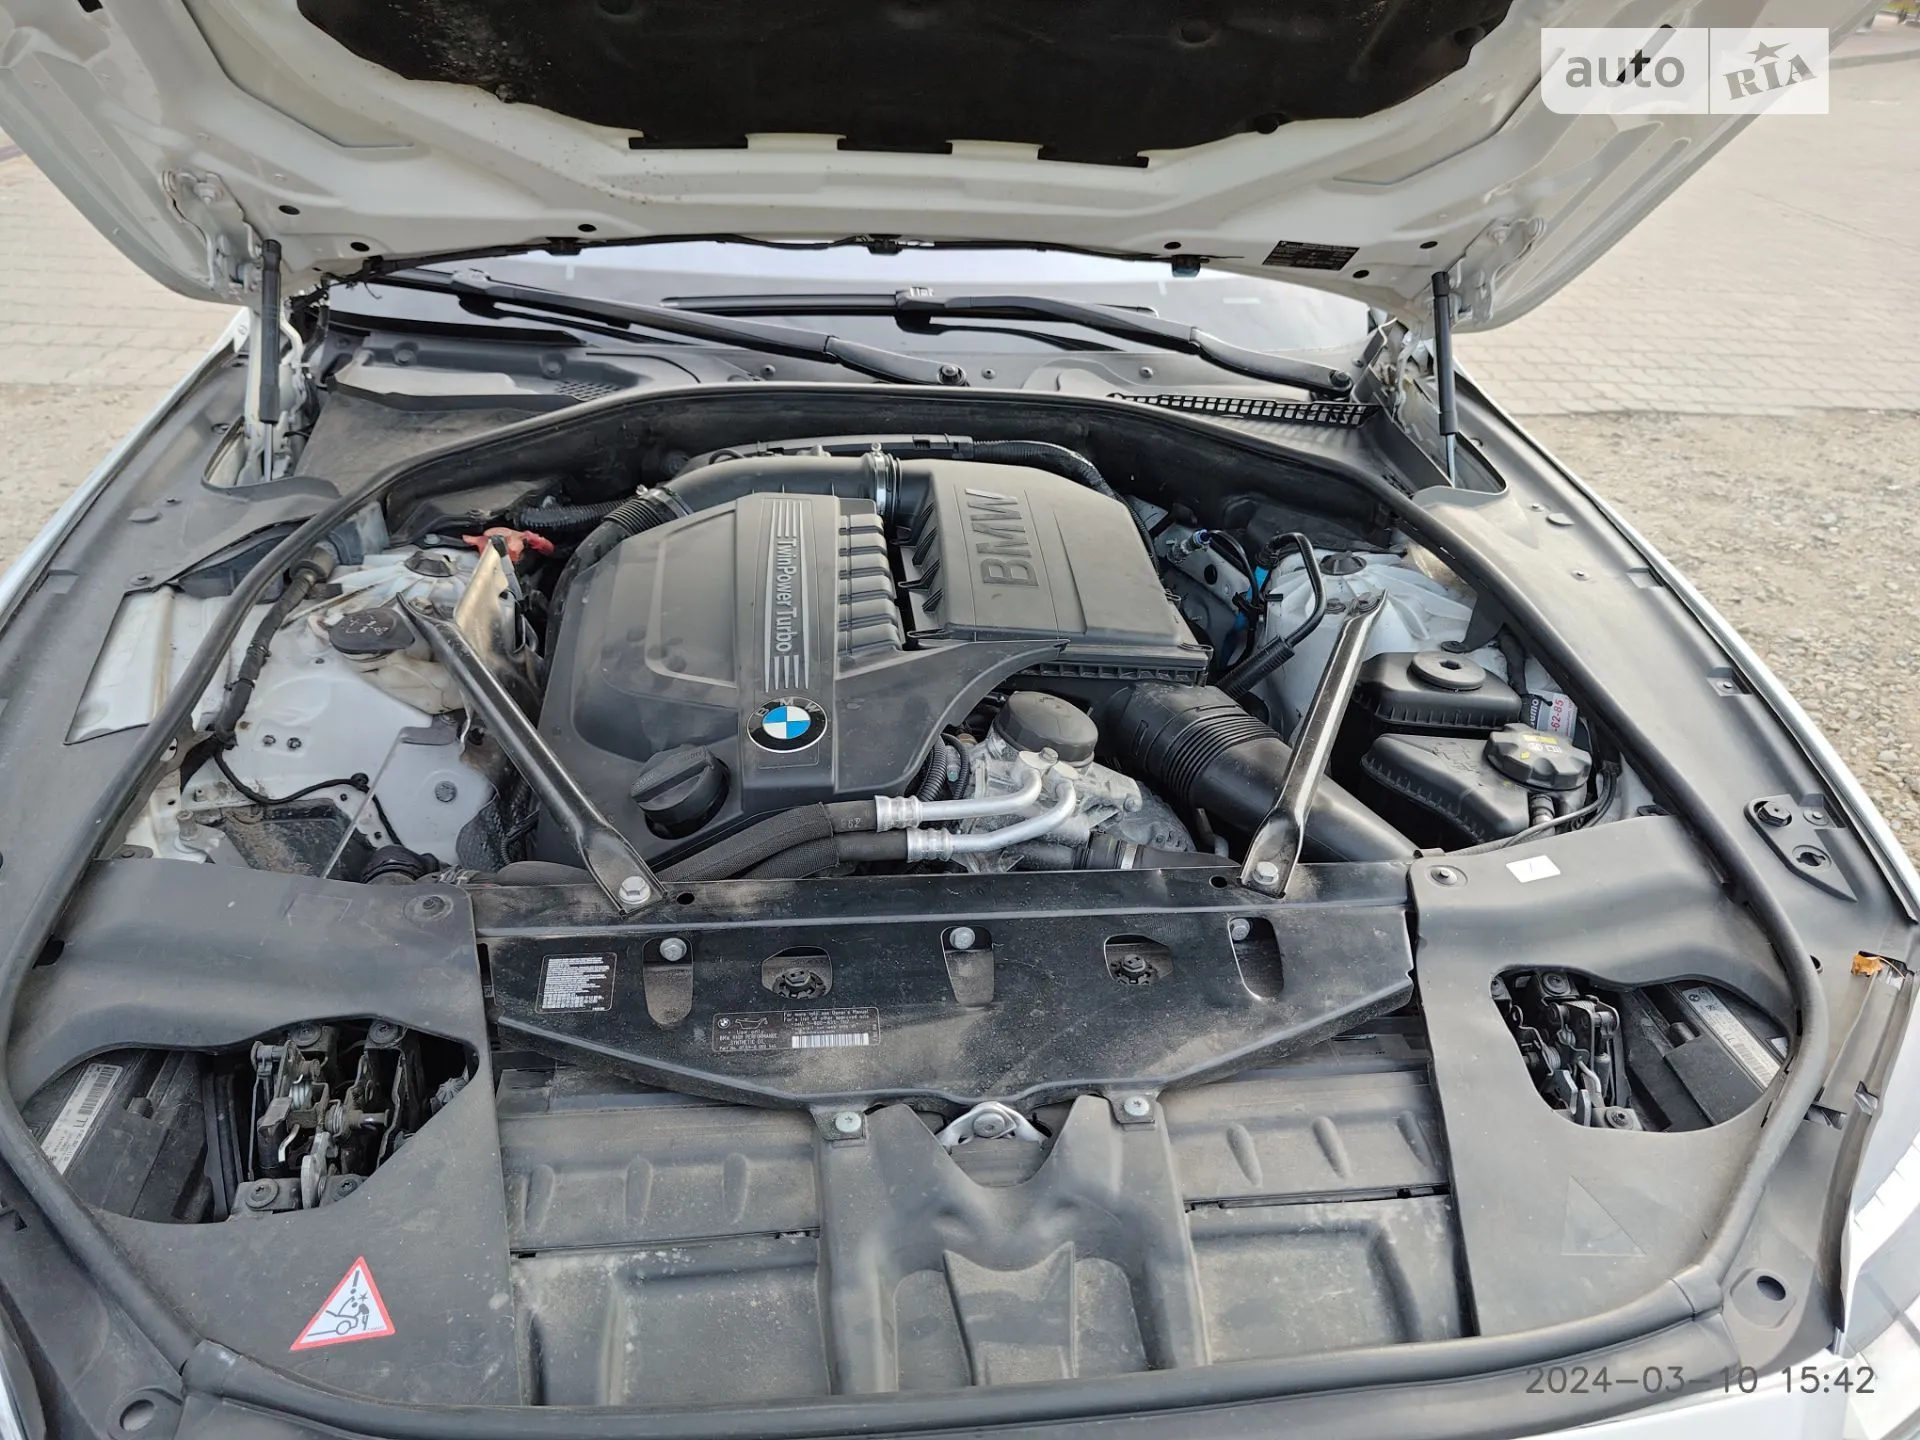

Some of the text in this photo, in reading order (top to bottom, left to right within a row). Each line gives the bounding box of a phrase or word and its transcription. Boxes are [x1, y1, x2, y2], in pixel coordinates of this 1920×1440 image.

[964, 487, 1040, 587] BMW
[775, 538, 799, 652] TwinPower Turbo
[754, 698, 820, 717] BMW
